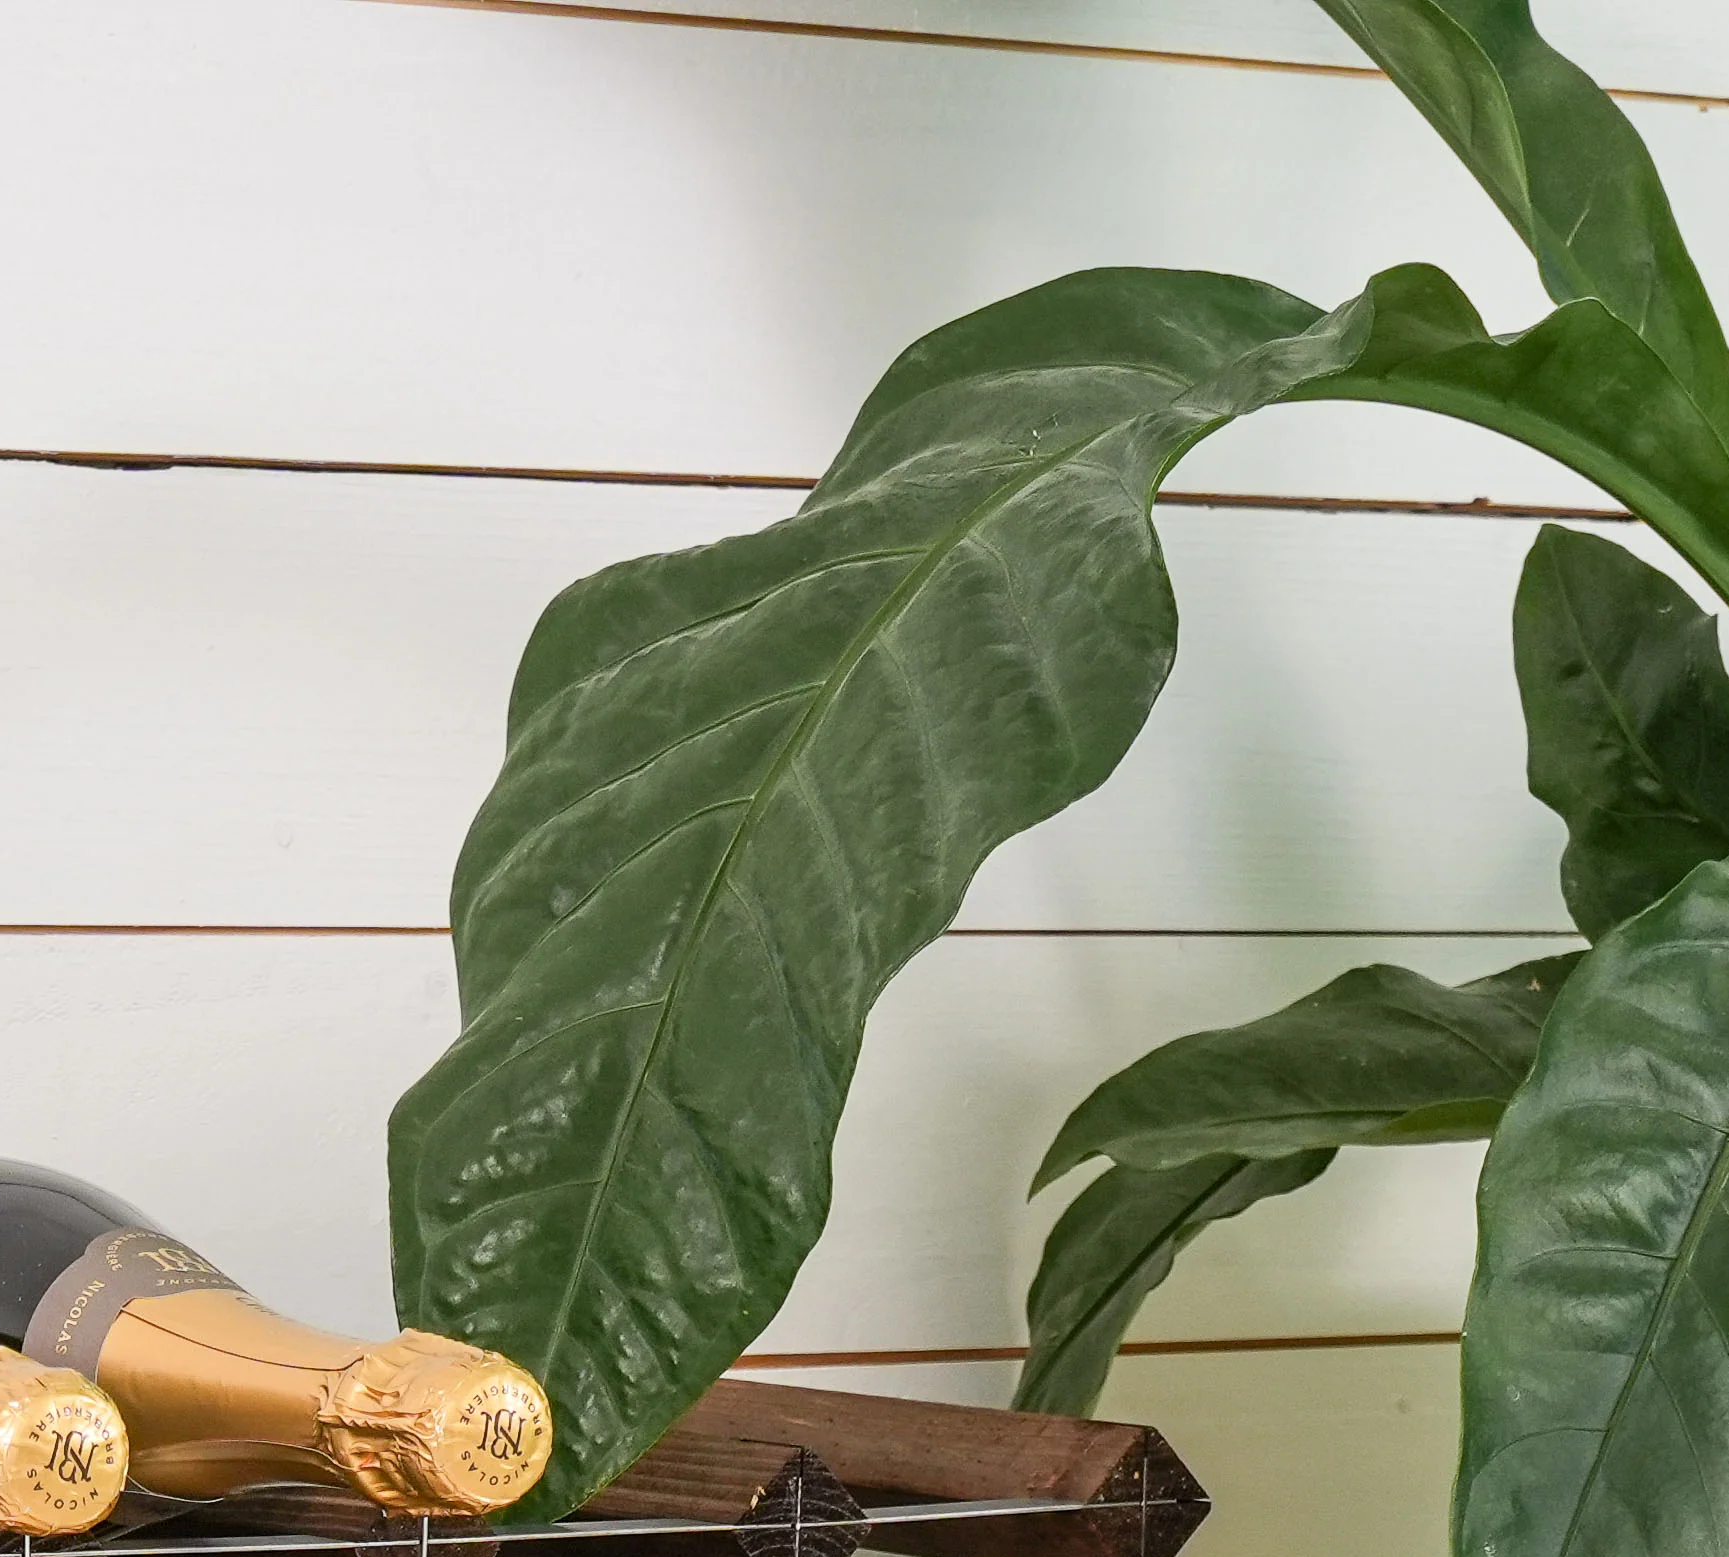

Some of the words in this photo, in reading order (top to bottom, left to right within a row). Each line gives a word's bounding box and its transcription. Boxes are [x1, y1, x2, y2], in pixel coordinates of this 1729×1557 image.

[55, 1280, 105, 1355] NICOLAS
[29, 1406, 114, 1465] BROBERGIERE
[460, 1385, 542, 1437] BROBERGIERE
[27, 1468, 99, 1510] NICOLAS
[461, 1450, 529, 1485] NICOLAS
